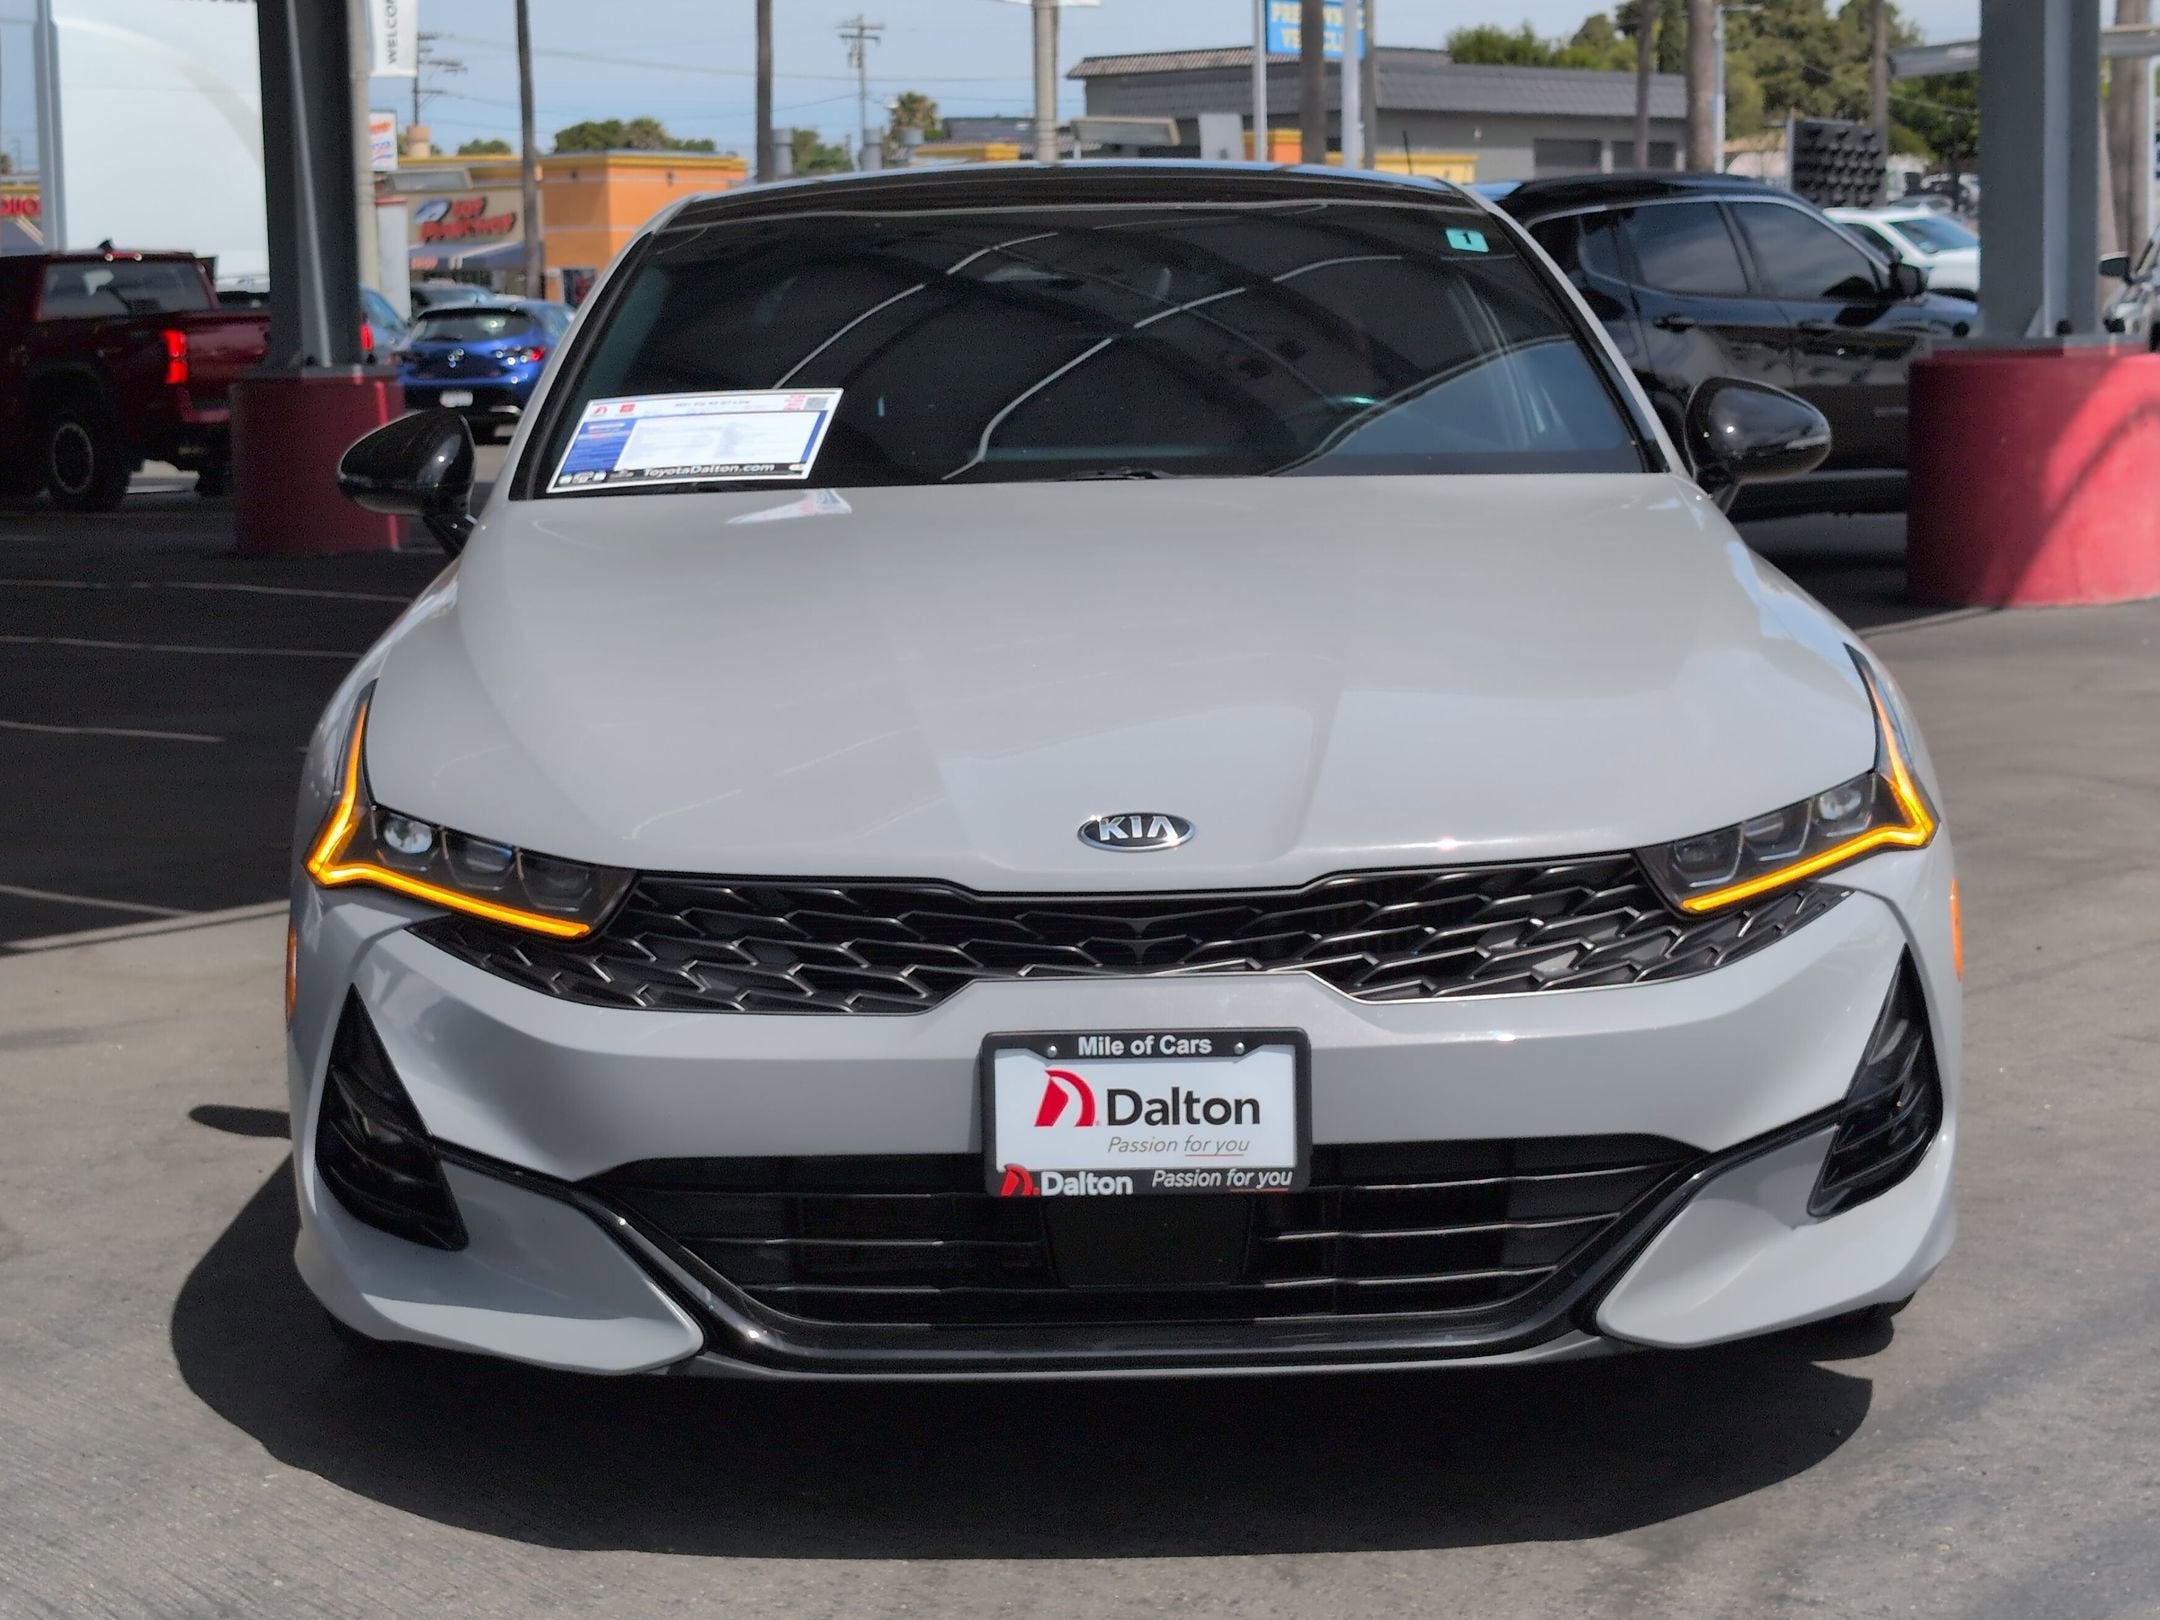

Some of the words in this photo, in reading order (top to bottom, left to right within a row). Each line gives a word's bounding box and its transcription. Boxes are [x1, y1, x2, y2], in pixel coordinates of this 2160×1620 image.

[385, 0, 398, 64] WELCO
[643, 464, 774, 478] ToyotaDalton.com
[1099, 815, 1178, 841] KIA
[1077, 1036, 1124, 1056] Mile
[1130, 1035, 1155, 1055] of
[1159, 1035, 1213, 1055] Cars
[1107, 1086, 1260, 1126] Dalton
[1107, 1136, 1177, 1153] Passion
[1184, 1135, 1211, 1154] for
[1215, 1138, 1249, 1155] you
[1040, 1172, 1133, 1196] Dalton
[1152, 1169, 1223, 1188] Passion
[1226, 1168, 1255, 1189] for
[1257, 1170, 1292, 1188] you
